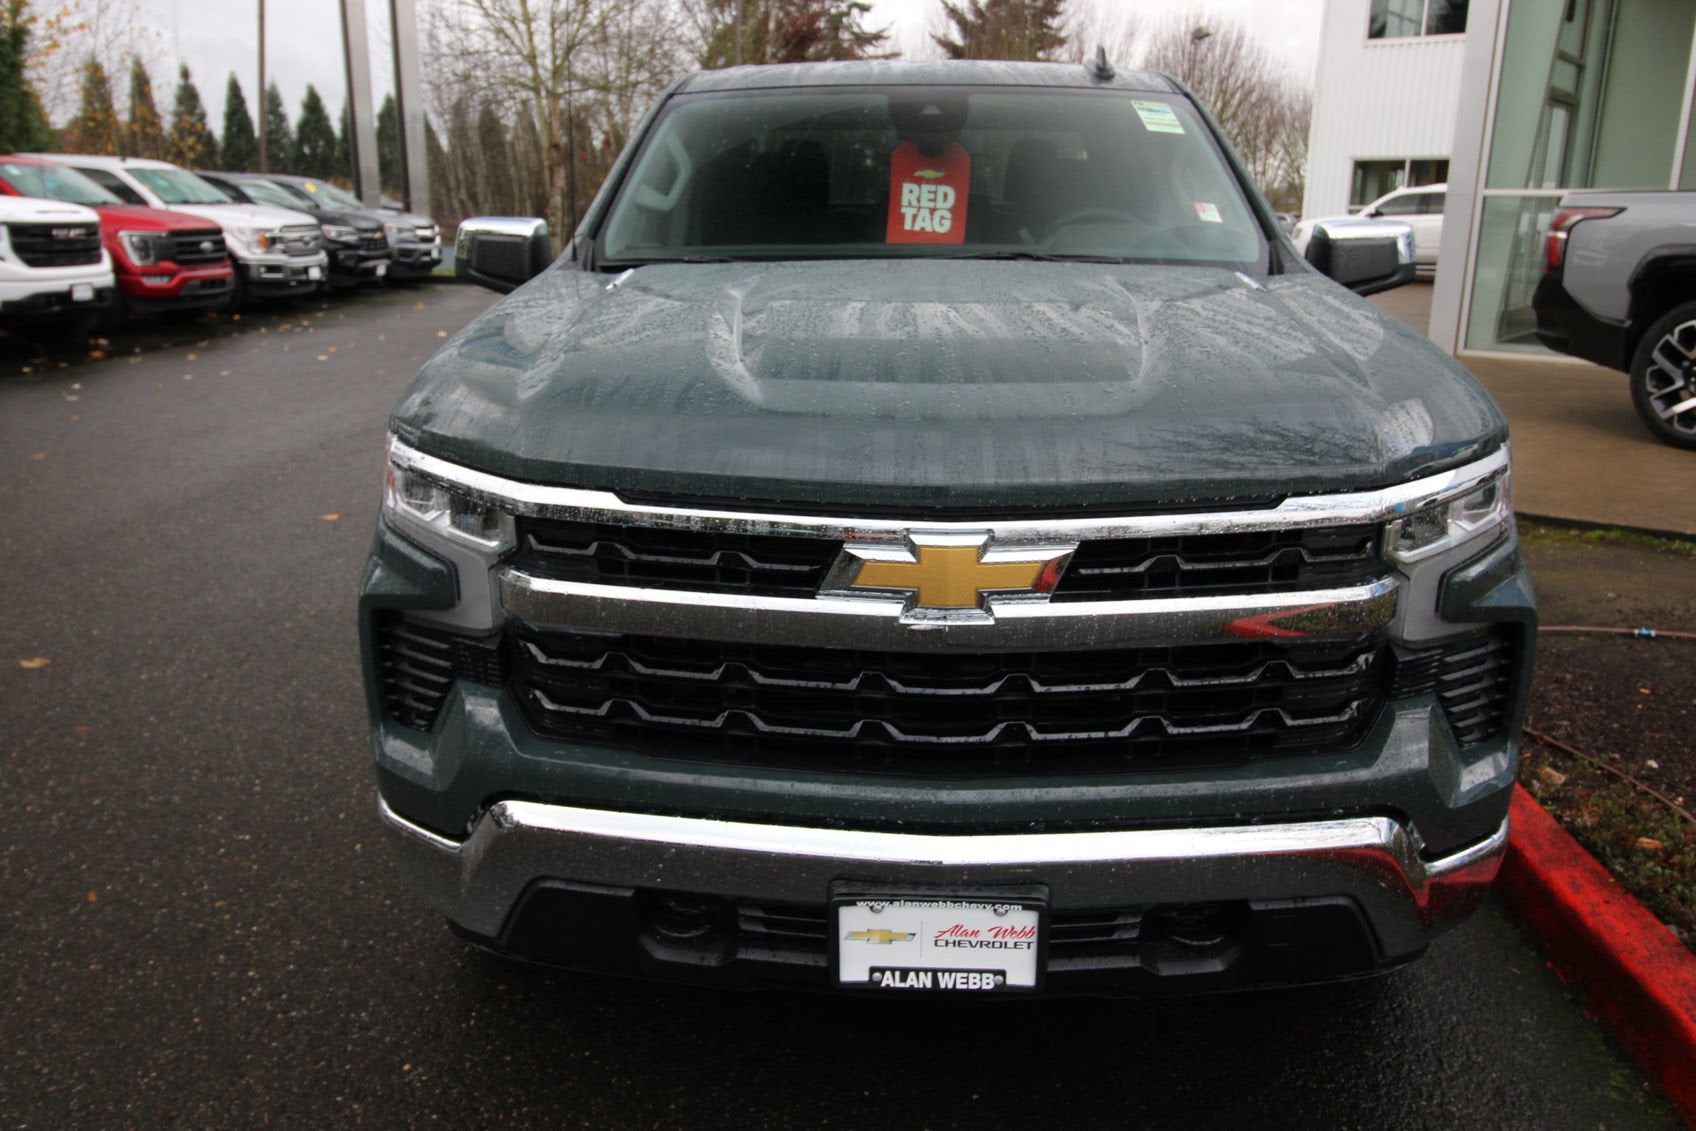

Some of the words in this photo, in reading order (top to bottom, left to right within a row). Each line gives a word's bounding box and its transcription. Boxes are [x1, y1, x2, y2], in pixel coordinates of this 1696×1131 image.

[902, 182, 956, 209] RED
[901, 207, 952, 234] TAG
[856, 899, 1023, 911] www.alanwebbchevy.com
[933, 924, 981, 939] Alan
[987, 925, 1036, 939] Webb
[934, 939, 1035, 950] CHEVROLET
[880, 970, 932, 989] ALAN
[937, 971, 995, 990] WEBB
